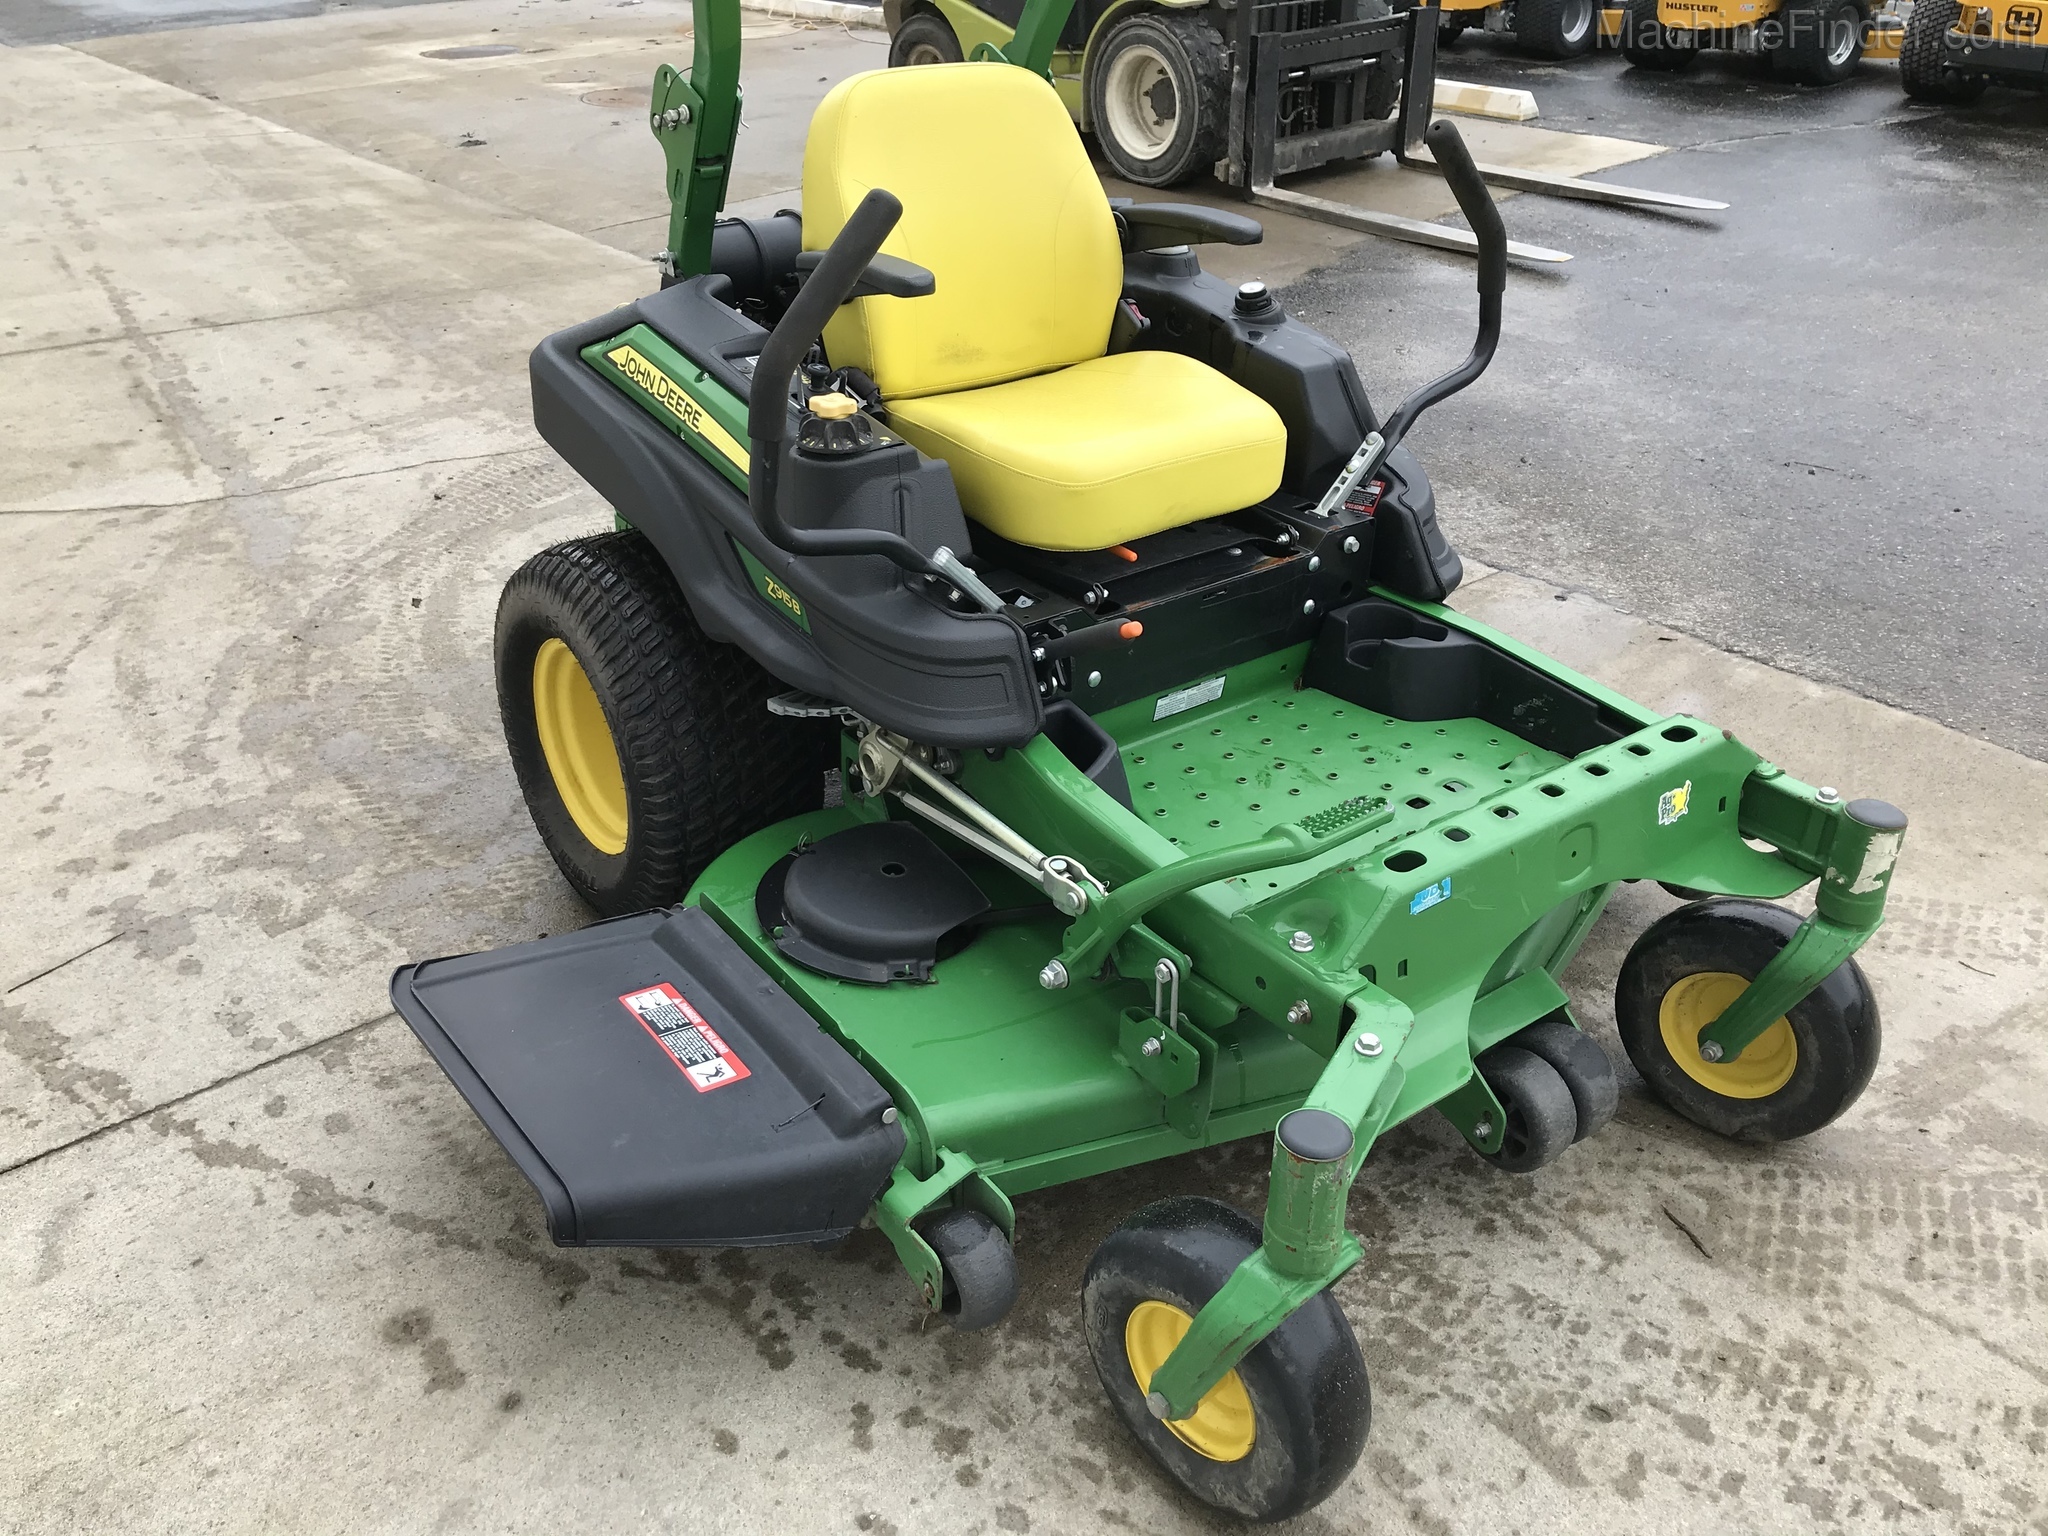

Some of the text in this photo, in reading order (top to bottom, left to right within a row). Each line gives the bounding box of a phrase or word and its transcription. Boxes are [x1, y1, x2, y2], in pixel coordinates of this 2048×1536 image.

[1665, 2, 1719, 13] HUSTLER
[619, 350, 703, 430] JOHN DEERE
[764, 575, 802, 616] Z915B
